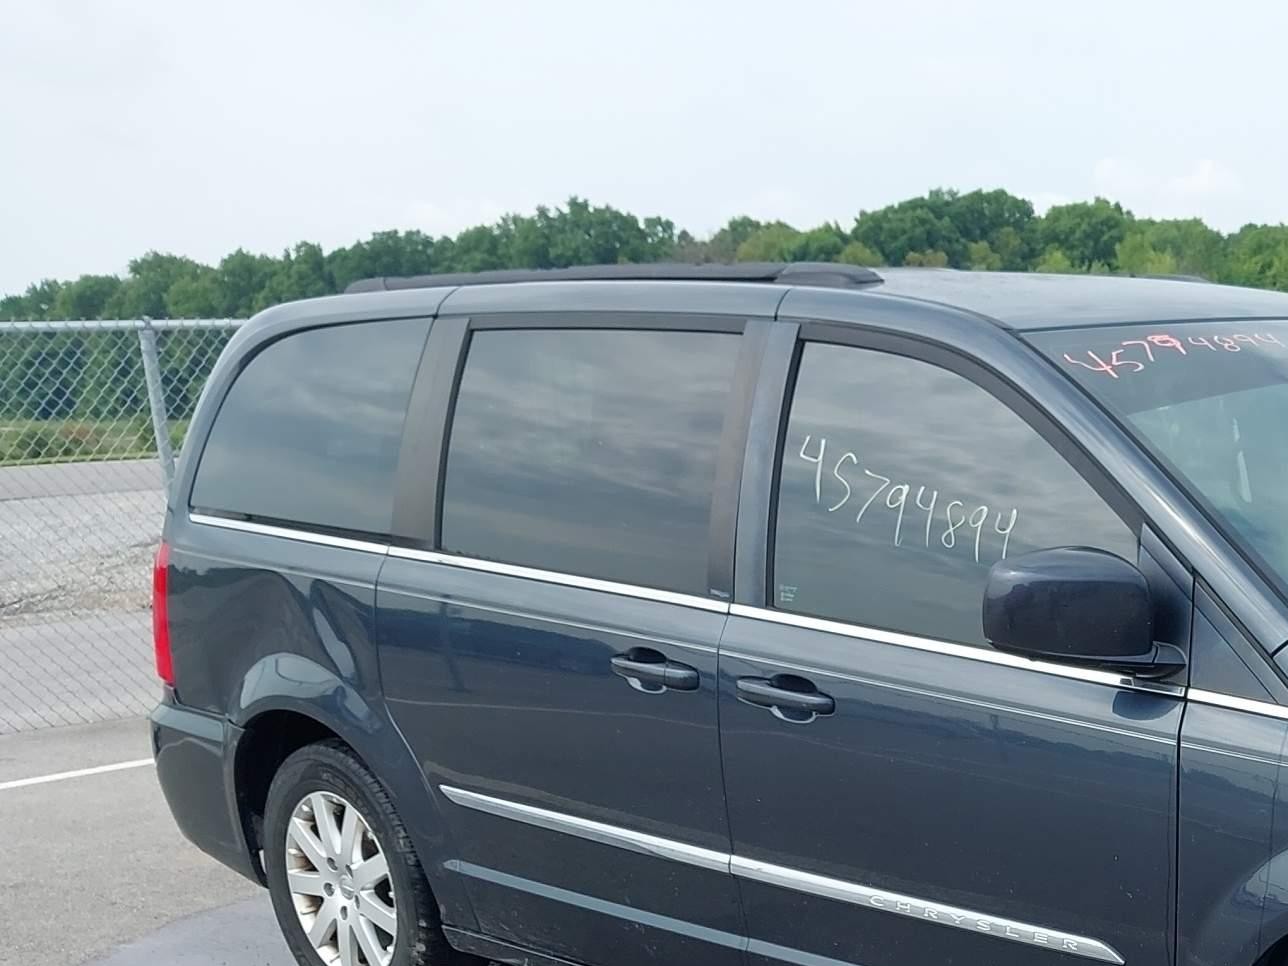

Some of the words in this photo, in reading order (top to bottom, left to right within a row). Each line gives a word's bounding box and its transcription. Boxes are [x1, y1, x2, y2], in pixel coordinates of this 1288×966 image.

[1063, 333, 1287, 379] 45794894
[799, 435, 1017, 563] 45794894
[869, 894, 1079, 951] CHRYSLER
